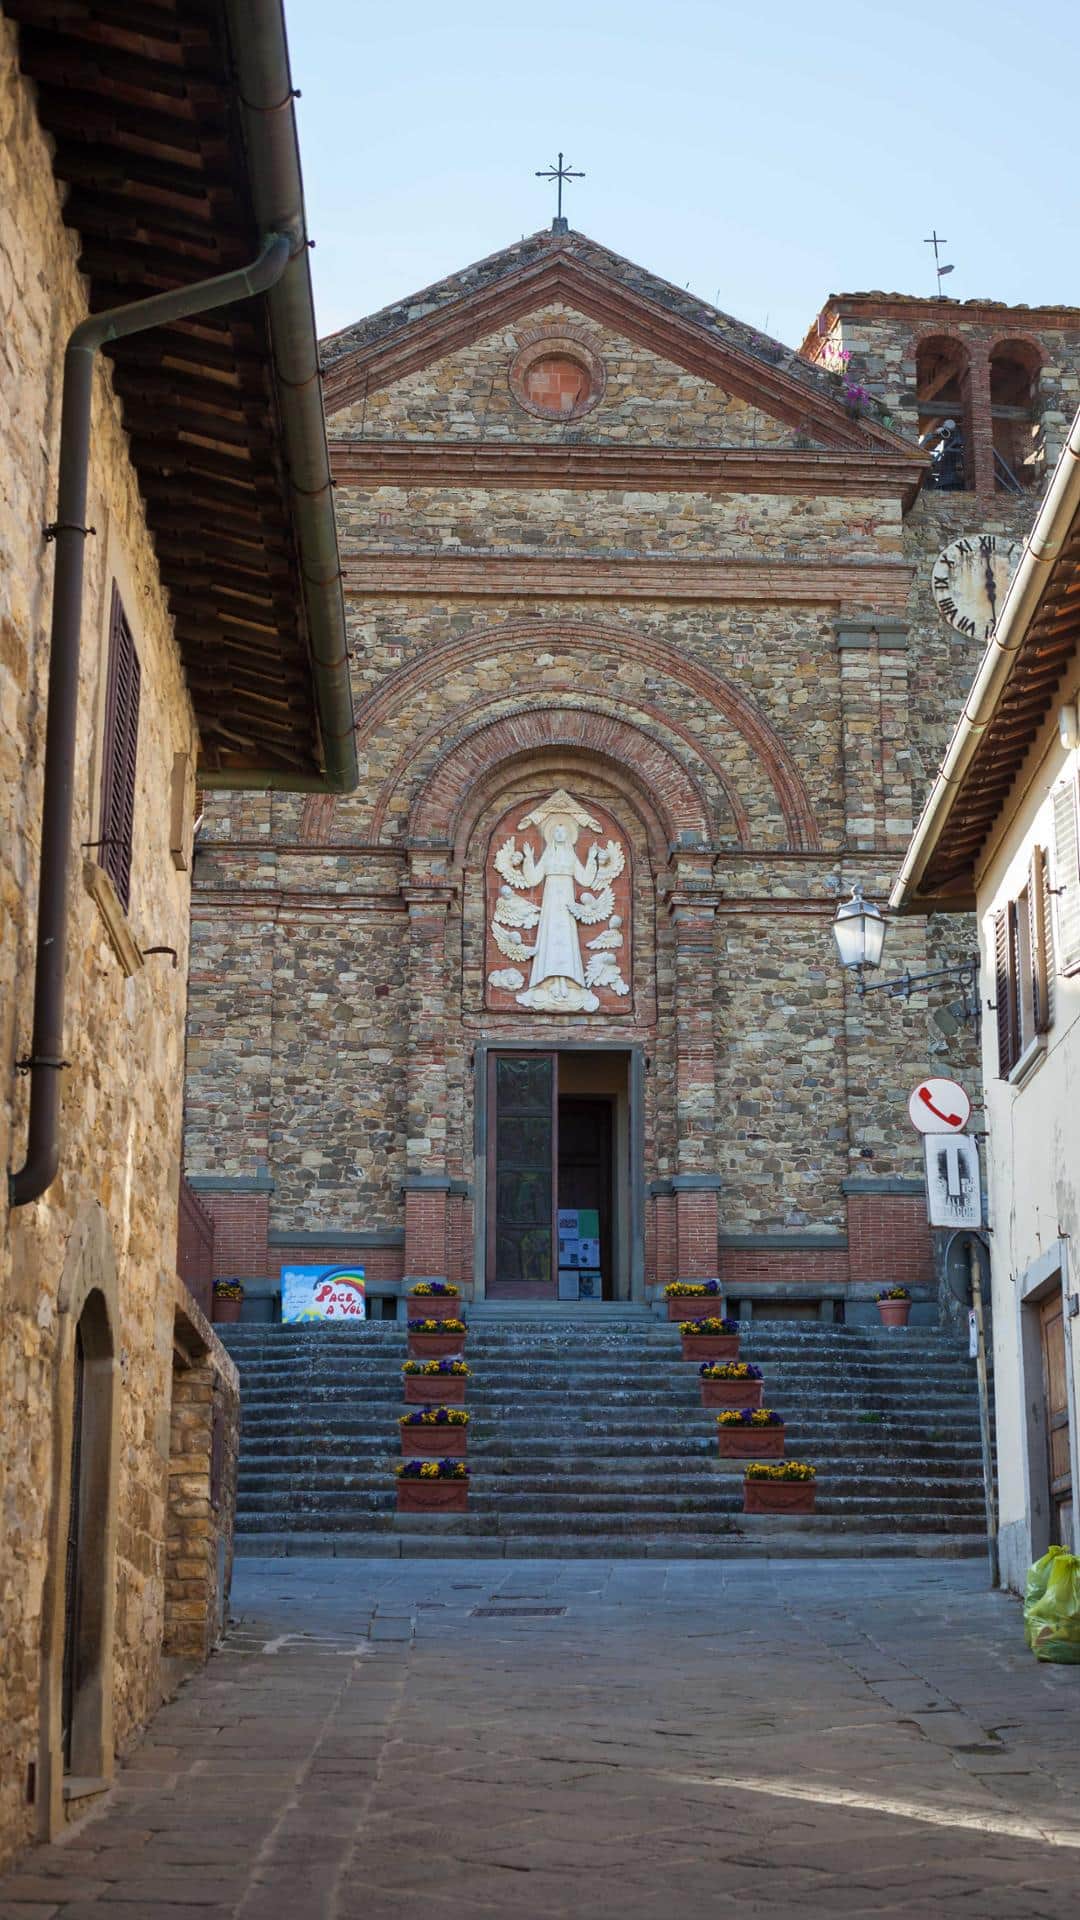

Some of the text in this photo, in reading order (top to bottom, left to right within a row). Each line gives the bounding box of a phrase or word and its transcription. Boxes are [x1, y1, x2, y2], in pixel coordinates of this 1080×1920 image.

[955, 539, 973, 556] XI
[979, 536, 996, 552] XII
[940, 554, 955, 569] X
[934, 576, 949, 589] IX
[938, 597, 958, 621] VIII
[957, 616, 976, 636] VII
[315, 1285, 353, 1303] PACE
[326, 1305, 334, 1315] A
